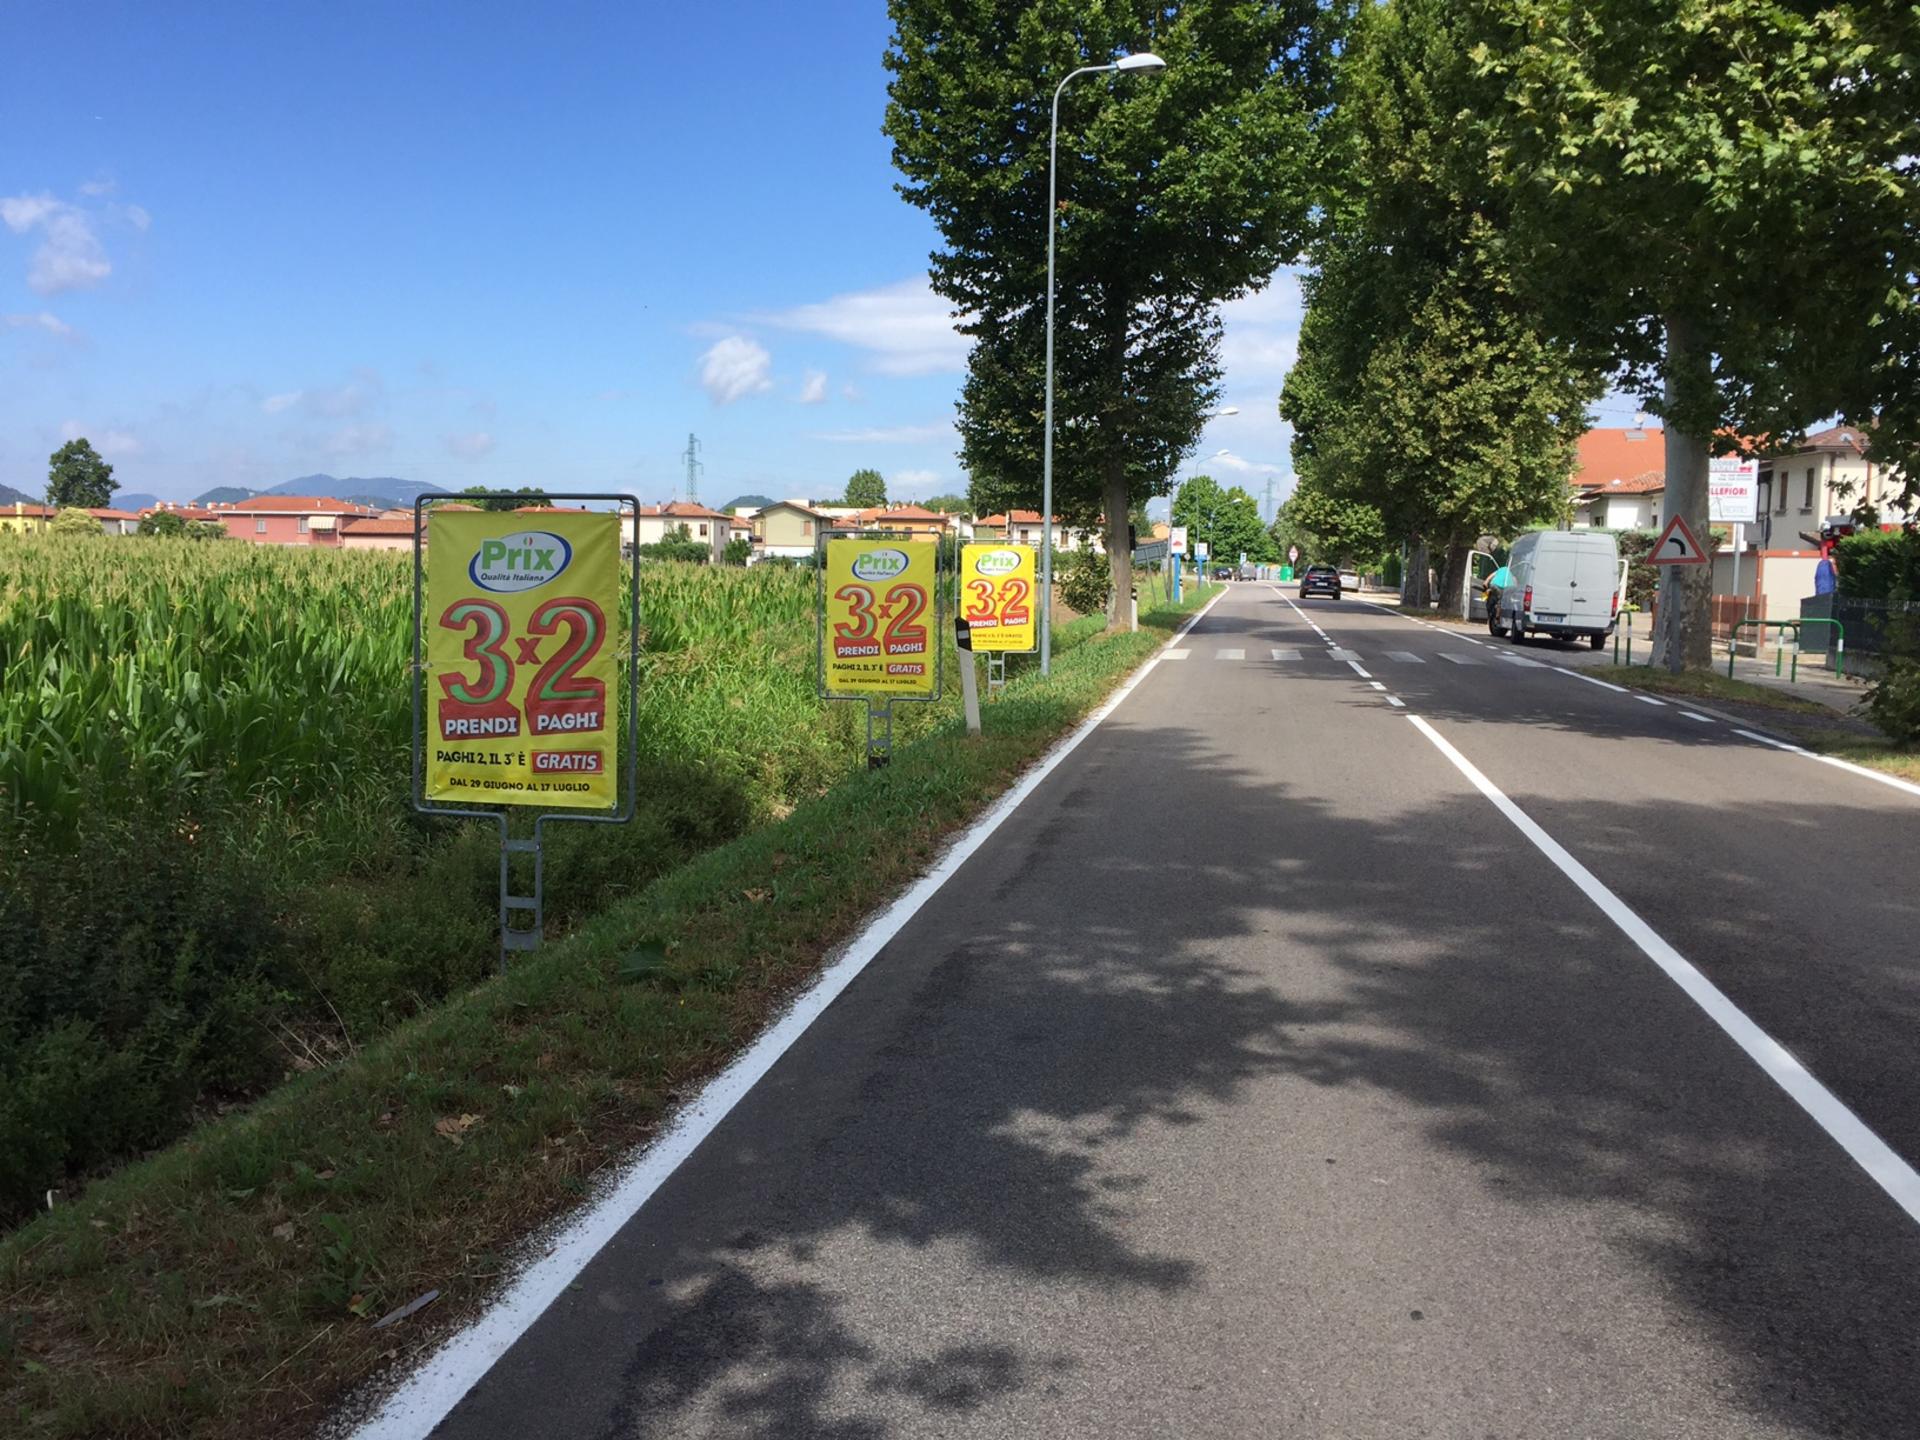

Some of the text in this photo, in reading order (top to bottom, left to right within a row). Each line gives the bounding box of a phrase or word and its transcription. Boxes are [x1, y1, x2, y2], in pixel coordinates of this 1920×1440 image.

[482, 537, 556, 571] Prix
[859, 552, 900, 570] Prix
[981, 553, 1014, 567] Prix
[512, 573, 545, 582] Italiana
[837, 645, 879, 656] PRENDI
[889, 642, 923, 654] PAGHI
[832, 663, 855, 671] PAGHI
[888, 664, 922, 674] GRATIS
[445, 716, 518, 736] PRENDI
[536, 711, 598, 731] PAGHI
[436, 750, 475, 764] PAGHI
[489, 752, 501, 765] IL
[518, 751, 526, 766] È
[536, 753, 598, 770] GRATIS
[450, 777, 590, 792] DAL 29 GIUGNO AL 17 LUGLIO
